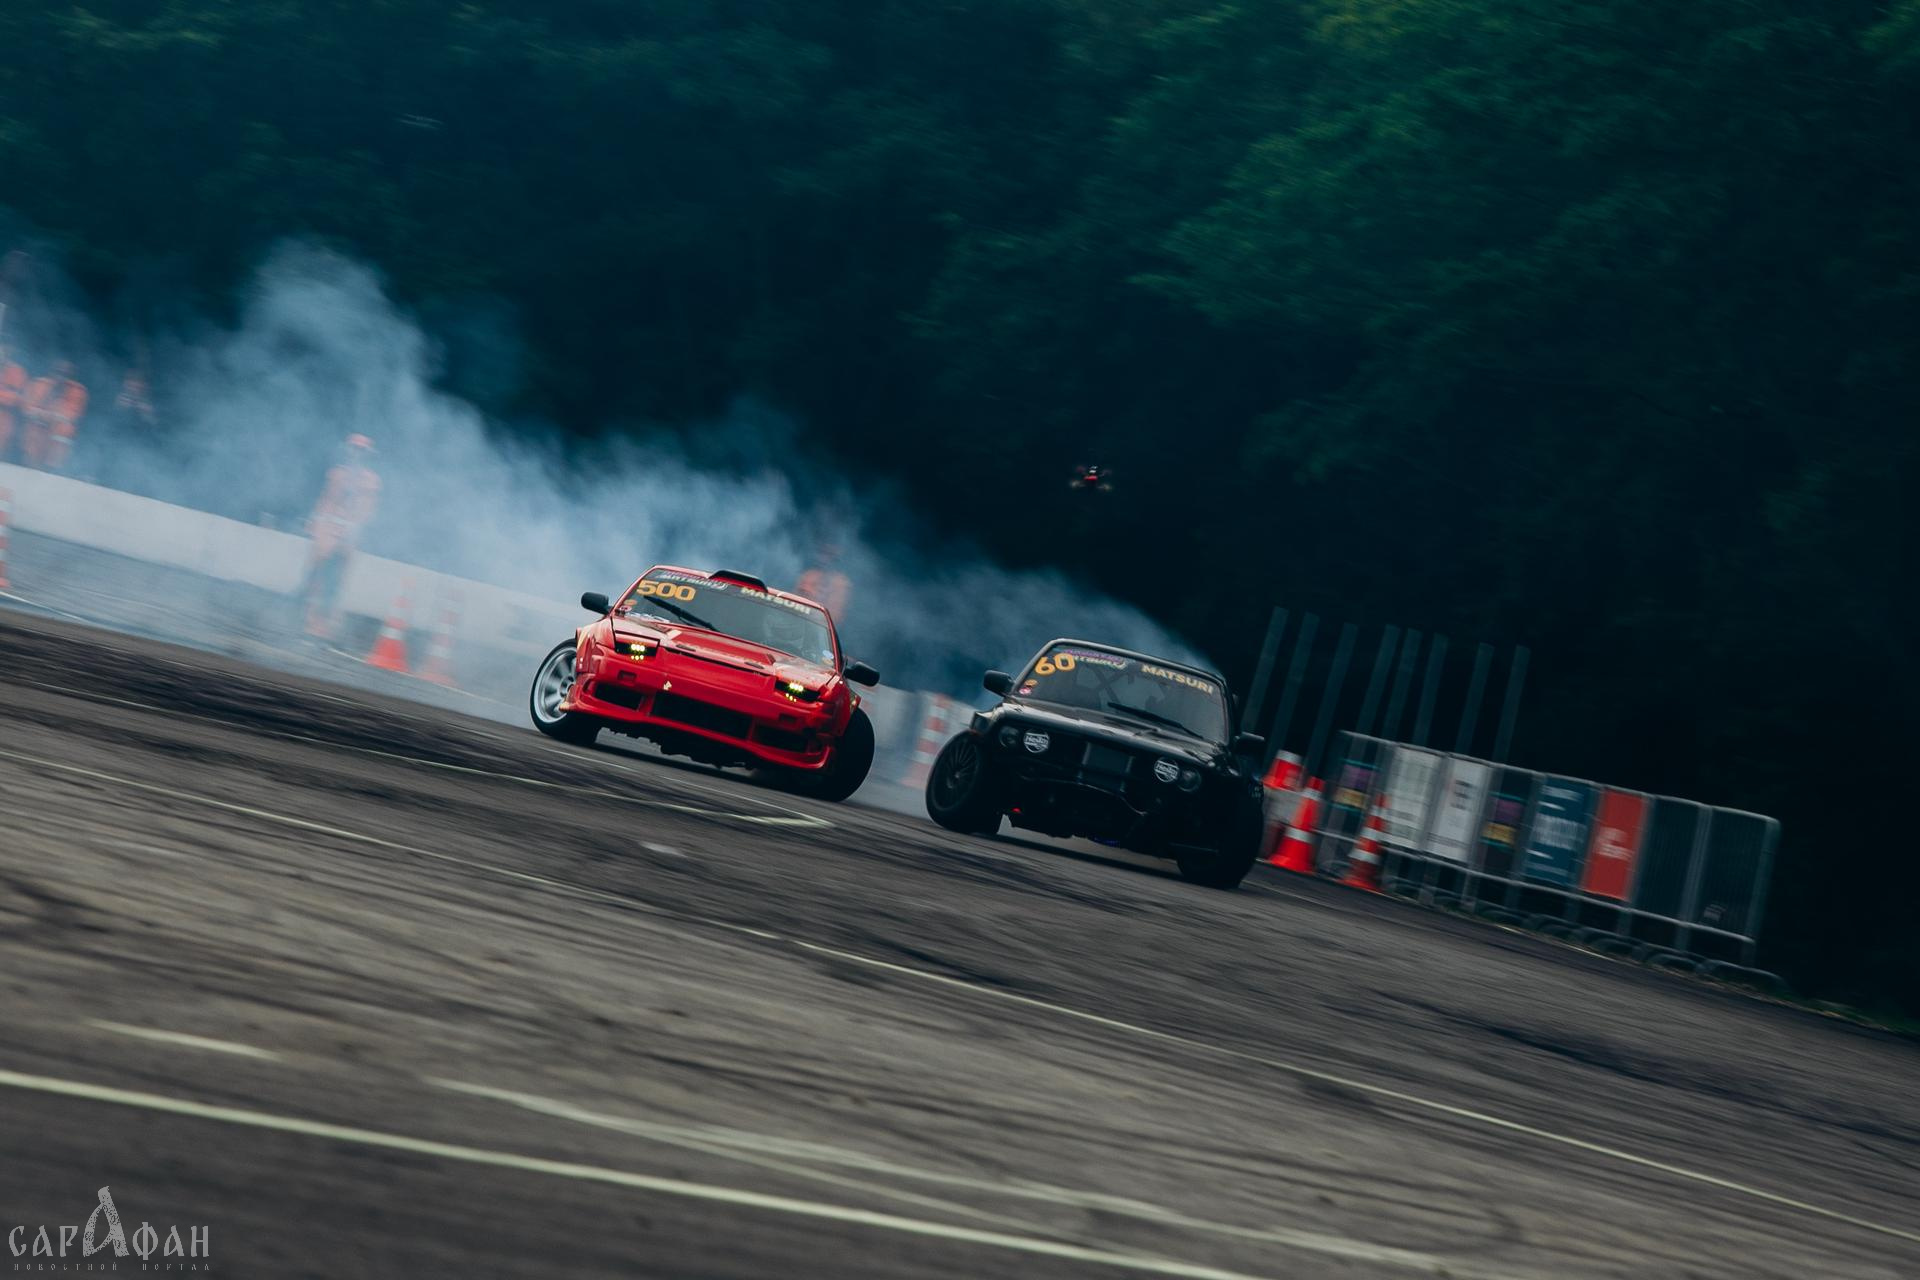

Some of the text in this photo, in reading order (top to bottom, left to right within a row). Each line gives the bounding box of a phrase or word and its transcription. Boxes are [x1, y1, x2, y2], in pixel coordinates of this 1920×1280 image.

[636, 579, 696, 602] 500
[740, 587, 811, 615] MATSURI
[1034, 652, 1076, 676] 60
[1141, 664, 1214, 694] MATSURI
